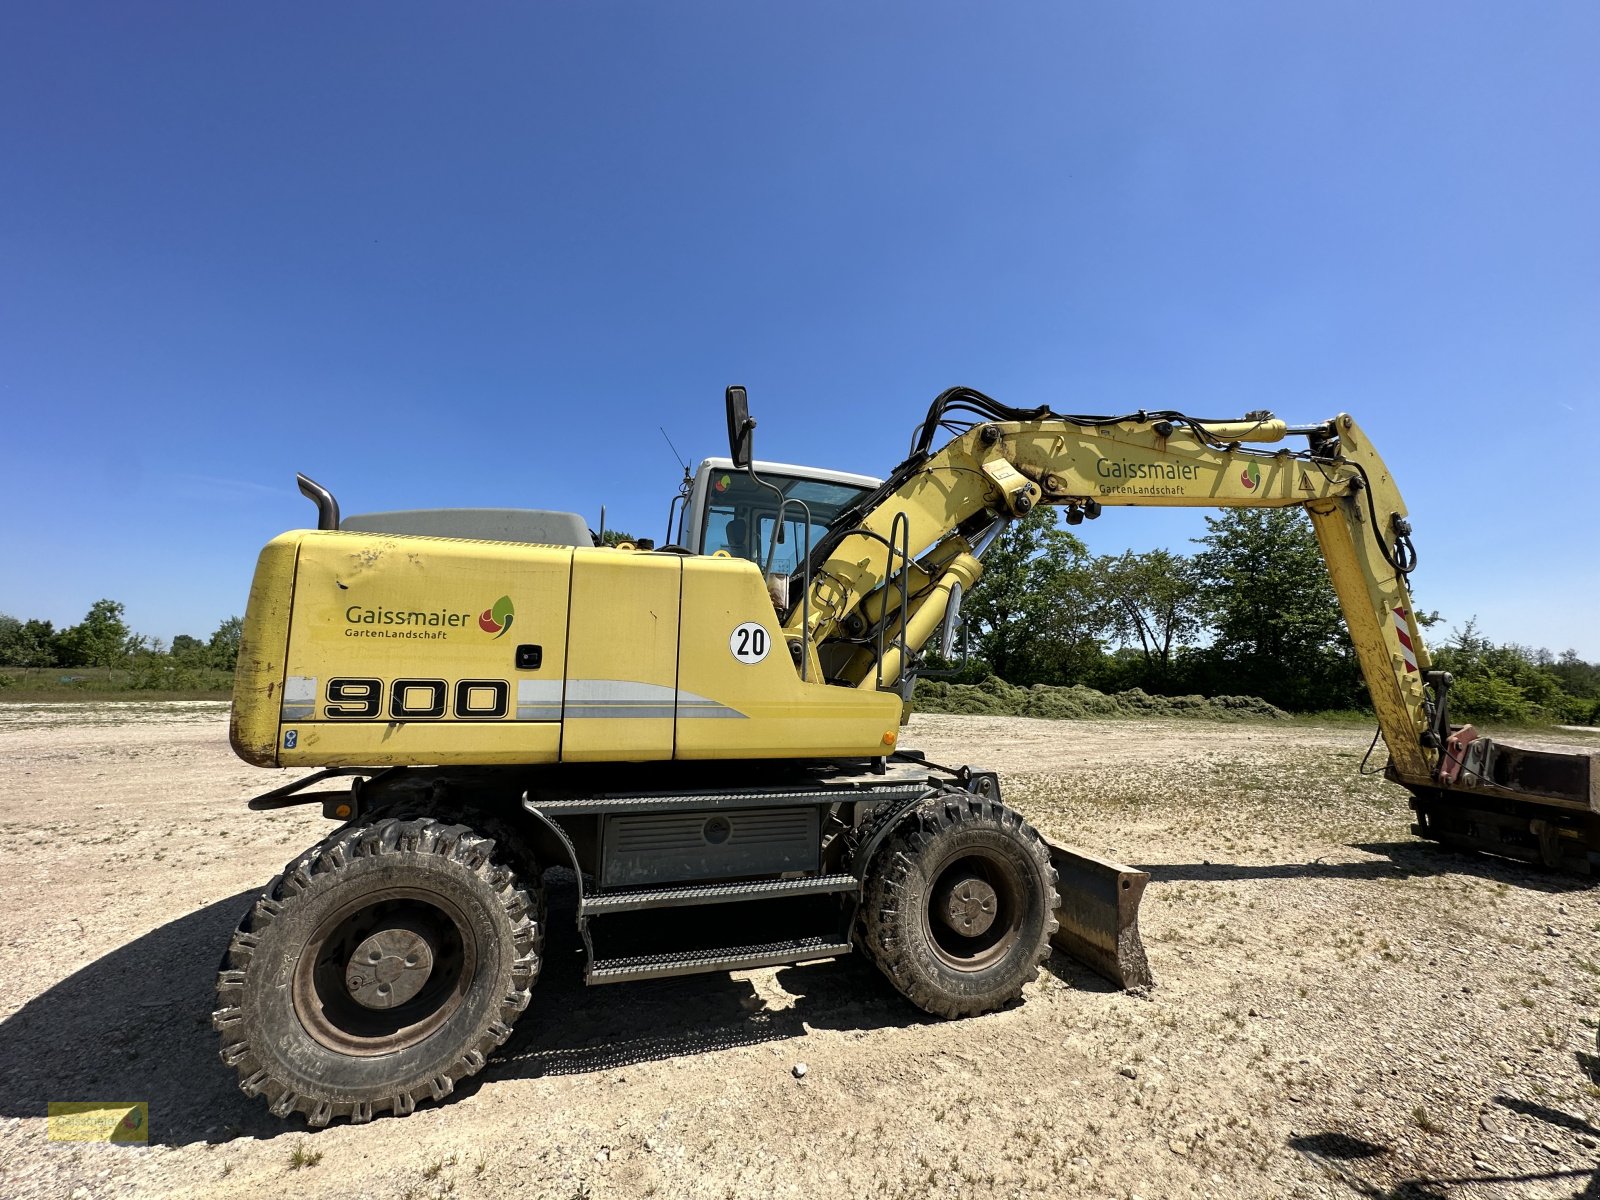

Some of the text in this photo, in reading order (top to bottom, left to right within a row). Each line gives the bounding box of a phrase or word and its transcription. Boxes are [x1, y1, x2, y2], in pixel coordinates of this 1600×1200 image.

[1096, 458, 1200, 480] Gaissmaier
[1099, 484, 1185, 495] GartenLandschaft
[345, 605, 471, 628] Gaissmaier
[344, 628, 448, 640] GartenLandschaft
[737, 628, 765, 656] 20
[324, 676, 511, 720] 900
